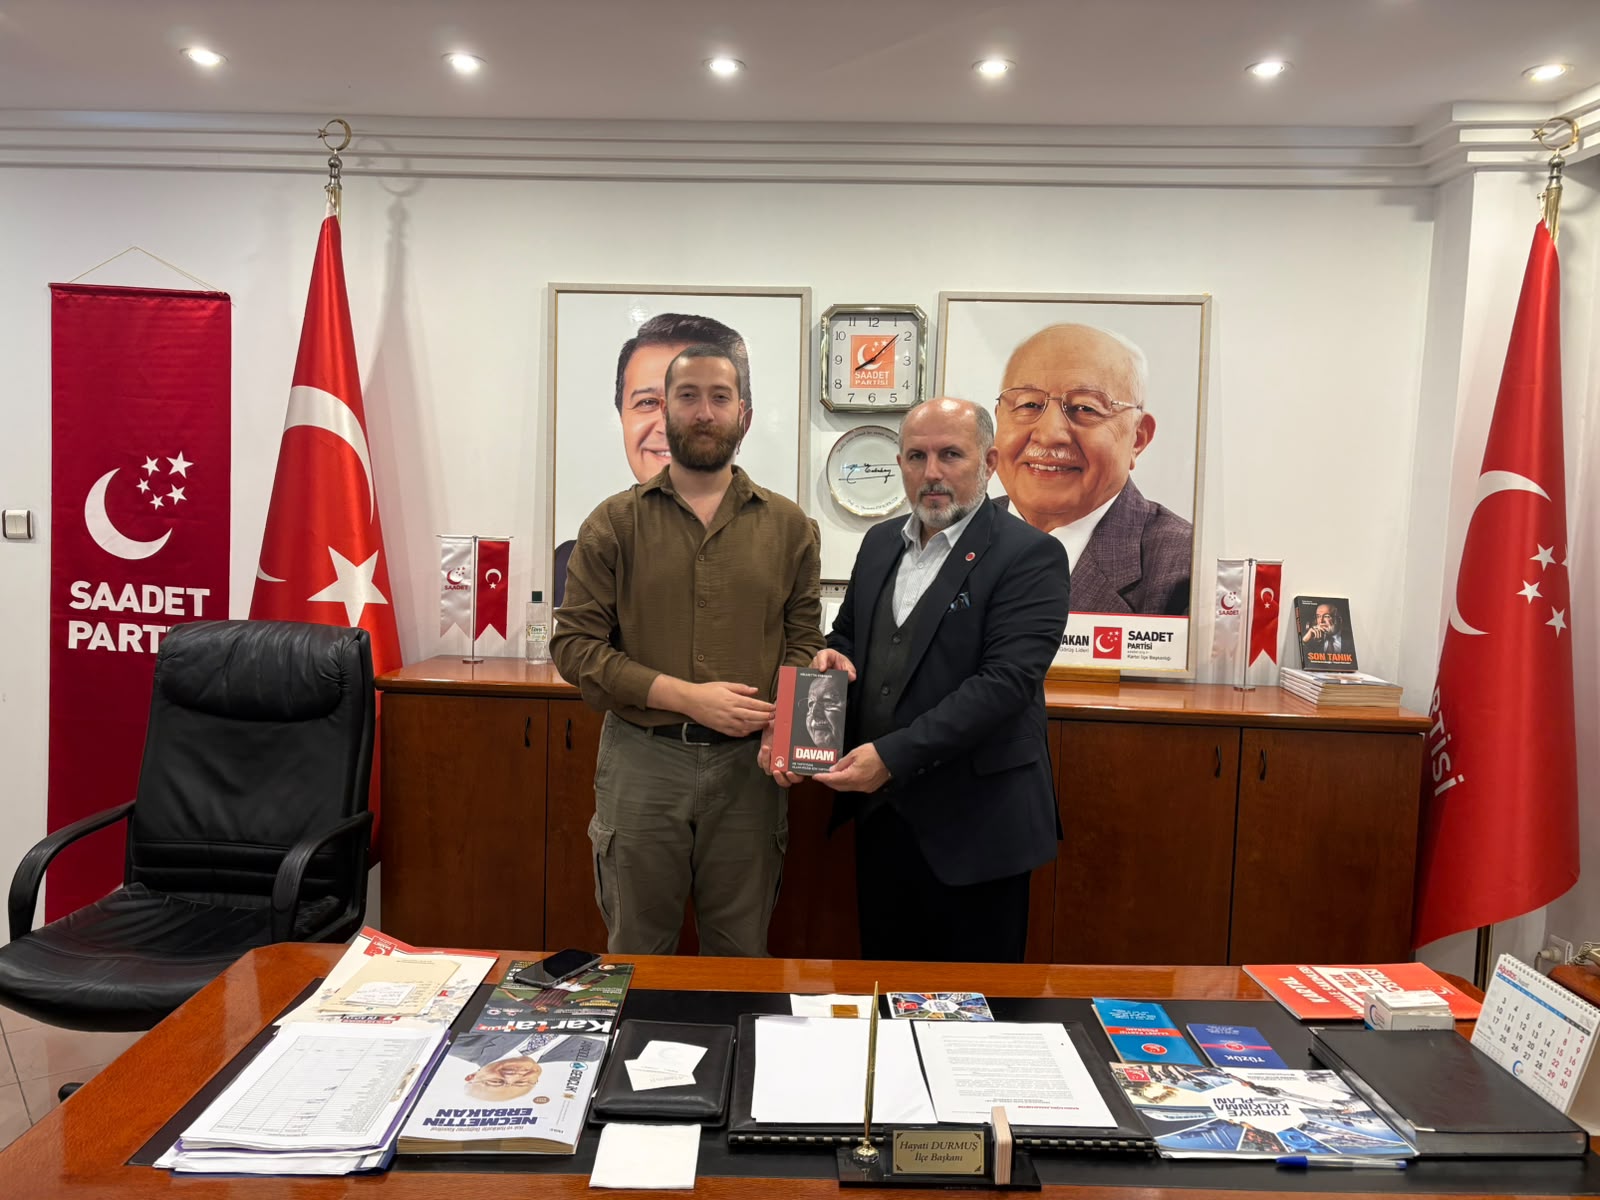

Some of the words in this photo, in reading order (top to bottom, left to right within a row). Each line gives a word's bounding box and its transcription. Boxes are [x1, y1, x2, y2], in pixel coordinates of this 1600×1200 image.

[848, 317, 856, 326] 11
[868, 317, 880, 328] 12
[894, 317, 898, 326] 1
[834, 331, 846, 341] 10
[904, 332, 912, 342] 2
[834, 356, 843, 366] 9
[904, 356, 912, 366] 3
[854, 370, 890, 379] SAADET
[834, 379, 843, 389] 8
[902, 380, 911, 390] 4
[847, 393, 856, 403] 7
[868, 393, 876, 403] 6
[889, 393, 898, 403] 5
[69, 580, 210, 616] SAADET
[68, 620, 172, 654] PART
[1062, 635, 1089, 646] AKAN
[1128, 630, 1174, 642] SAADET
[1128, 642, 1152, 650] PARTİSİ
[1308, 652, 1325, 660] SON
[1327, 653, 1352, 662] TANIK
[1430, 685, 1465, 796] RTİSİ
[796, 748, 834, 762] DAVAM
[1360, 968, 1404, 992] OSYASI
[1278, 976, 1330, 1003] KARTAL
[503, 1020, 613, 1033] Kartal
[1496, 1006, 1503, 1015] 10
[1507, 1013, 1514, 1023] 11
[1520, 1021, 1526, 1031] 12
[1532, 1030, 1538, 1039] 13
[1543, 1038, 1551, 1048] 14
[1556, 1047, 1563, 1057] 15
[1569, 1057, 1576, 1066] 16
[1526, 1013, 1530, 1021] 5
[1538, 1021, 1542, 1029] 6
[1563, 1038, 1567, 1046] 8
[1576, 1047, 1581, 1055] 9
[1568, 1027, 1571, 1035] 1
[1579, 1036, 1584, 1044] 2
[1493, 1016, 1499, 1025] 17
[1504, 1024, 1511, 1034] 18
[1516, 1032, 1523, 1042] 19
[1527, 1041, 1534, 1050] 20
[1539, 1049, 1546, 1059] 21
[1552, 1059, 1559, 1069] 22
[1564, 1067, 1571, 1077] 23
[1224, 1054, 1265, 1062] TÜZÜK
[1499, 1034, 1507, 1044] 25
[1511, 1043, 1519, 1053] 26
[1523, 1051, 1530, 1061] 27
[1535, 1061, 1542, 1070] 28
[1547, 1070, 1555, 1079] 29
[1559, 1078, 1567, 1089] 30
[436, 1108, 533, 1117] ERBAKAN
[422, 1117, 538, 1126] NECMETTİN
[900, 1141, 928, 1151] Hayati
[931, 1142, 978, 1151] DURMUŞ
[915, 1152, 928, 1163] İlçe
[931, 1153, 963, 1163] Başkanı
